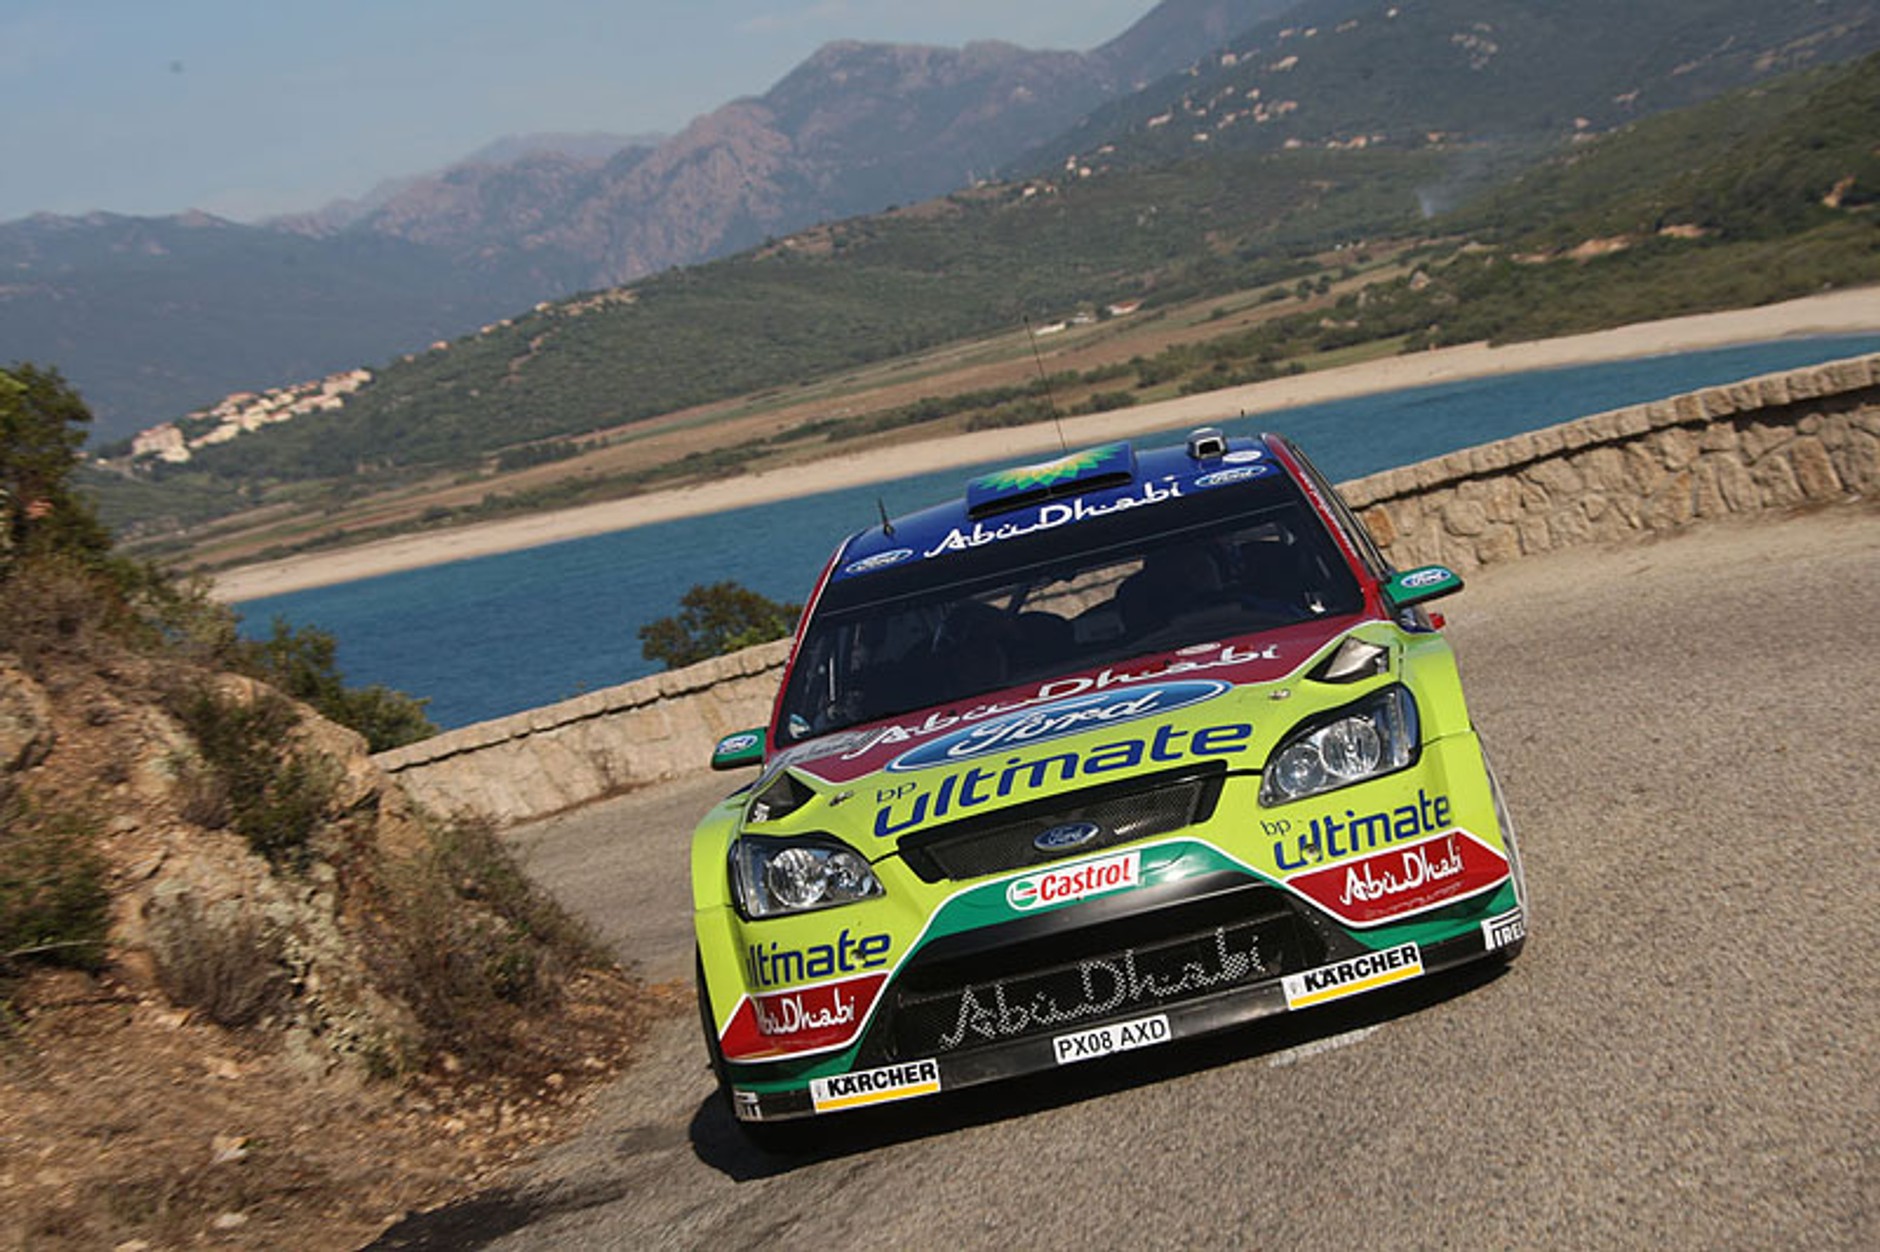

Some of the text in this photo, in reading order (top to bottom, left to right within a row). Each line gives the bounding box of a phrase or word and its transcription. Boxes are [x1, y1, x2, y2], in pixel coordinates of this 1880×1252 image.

[947, 690, 1166, 757] Ford
[873, 723, 1253, 838] ultimate
[876, 781, 917, 805] bp
[1260, 819, 1292, 837] bp
[1274, 789, 1452, 871] ultimate
[1040, 857, 1132, 902] Castrol
[1303, 945, 1418, 993] KÄRCHER
[1057, 1019, 1167, 1061] PX08 AXD
[827, 1062, 937, 1097] KÄRCHER
